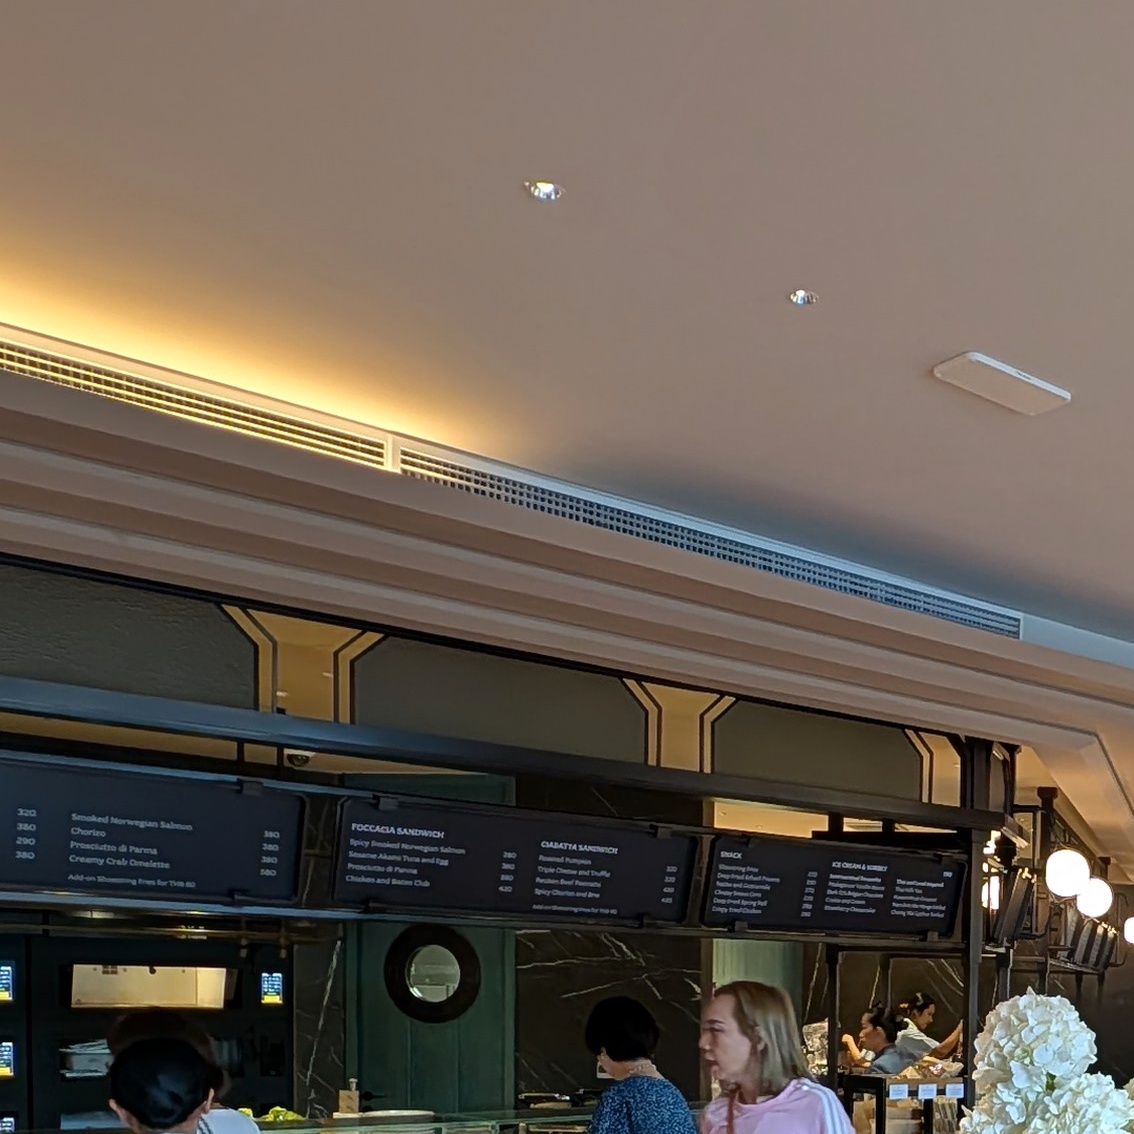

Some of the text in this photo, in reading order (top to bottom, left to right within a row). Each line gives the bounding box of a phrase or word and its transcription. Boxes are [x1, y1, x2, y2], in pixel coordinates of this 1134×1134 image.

[17, 808, 37, 817] 320
[71, 813, 194, 831] Smoked Norwegian Salmon
[70, 827, 106, 837] Chorizo
[351, 823, 445, 839] FOCCACIA SANDWICH
[16, 837, 36, 846] 290
[70, 840, 158, 855] Prosciutto di Parma
[578, 844, 619, 854] SANDWICH
[69, 855, 170, 869] Creamy Crab Omelette
[346, 875, 375, 884] Chicken
